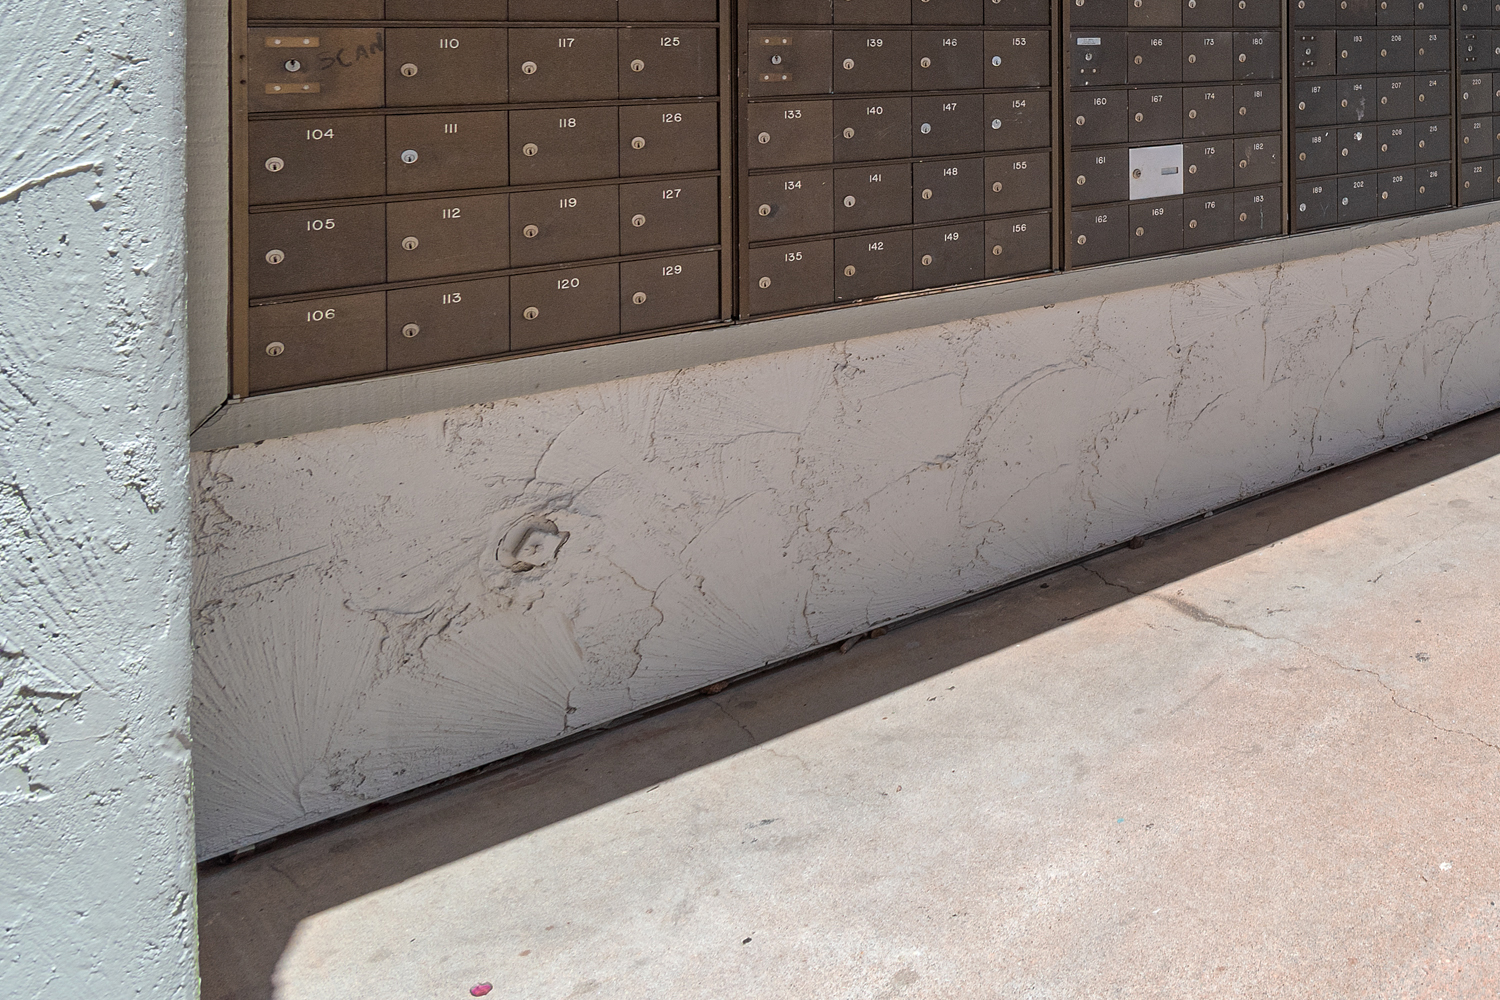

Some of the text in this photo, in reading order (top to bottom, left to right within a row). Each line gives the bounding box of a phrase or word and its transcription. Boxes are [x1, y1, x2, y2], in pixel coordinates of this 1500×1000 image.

[439, 38, 460, 49] 110
[558, 37, 575, 48] 117
[660, 36, 681, 47] 125
[866, 38, 883, 48] 139
[942, 38, 958, 47] 146
[1012, 37, 1027, 46] 153
[1150, 38, 1163, 47] 166
[1203, 38, 1215, 46] 173
[1252, 37, 1264, 46] 180
[1353, 35, 1363, 43] 193
[316, 31, 384, 71] SCAN
[1311, 85, 1322, 94] 187
[1391, 81, 1402, 89] 207
[1151, 94, 1163, 103] 167
[1204, 92, 1216, 100] 174
[1253, 90, 1263, 98] 181
[1012, 99, 1026, 108] 154
[1093, 97, 1107, 106] 160
[866, 106, 884, 115] 140
[942, 102, 957, 112] 147
[662, 112, 682, 123] 126
[784, 109, 802, 120] 133
[559, 117, 577, 128] 118
[444, 123, 458, 134] 111
[306, 128, 335, 140] 104
[1204, 146, 1216, 155] 175
[1253, 142, 1264, 151] 182
[1012, 161, 1028, 170] 155
[1095, 156, 1106, 165] 161
[943, 167, 958, 177] 148
[869, 173, 882, 183] 141
[1392, 175, 1404, 183] 209
[784, 180, 802, 191] 134
[1353, 180, 1365, 189] 202
[662, 188, 682, 200] 127
[1312, 186, 1323, 194] 189
[559, 197, 577, 209] 119
[1253, 194, 1265, 203] 183
[1204, 200, 1216, 209] 176
[442, 207, 461, 219] 112
[1152, 207, 1164, 216] 169
[1095, 214, 1108, 224] 162
[307, 218, 336, 231] 105
[1012, 223, 1027, 233] 156
[944, 232, 959, 242] 149
[868, 241, 884, 252] 142
[784, 251, 803, 262] 135
[662, 264, 682, 276] 129
[557, 277, 580, 290] 120
[442, 292, 462, 305] 113
[307, 308, 336, 322] 106
